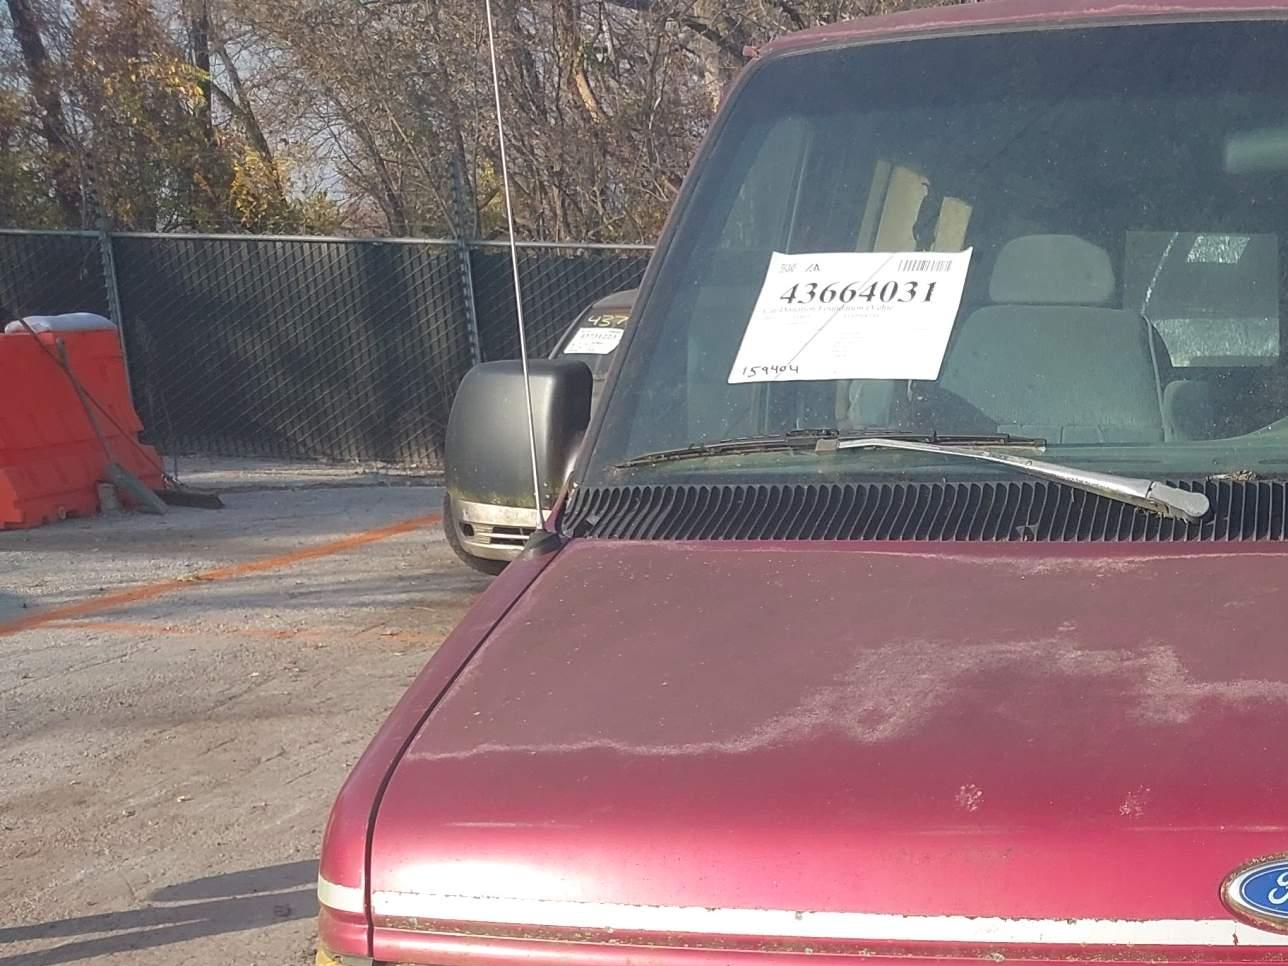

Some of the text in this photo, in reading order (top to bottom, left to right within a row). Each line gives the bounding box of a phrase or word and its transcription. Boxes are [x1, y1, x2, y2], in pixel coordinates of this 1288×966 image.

[779, 280, 937, 304] 43664031
[588, 314, 629, 327] 437
[742, 364, 799, 378] 159404
